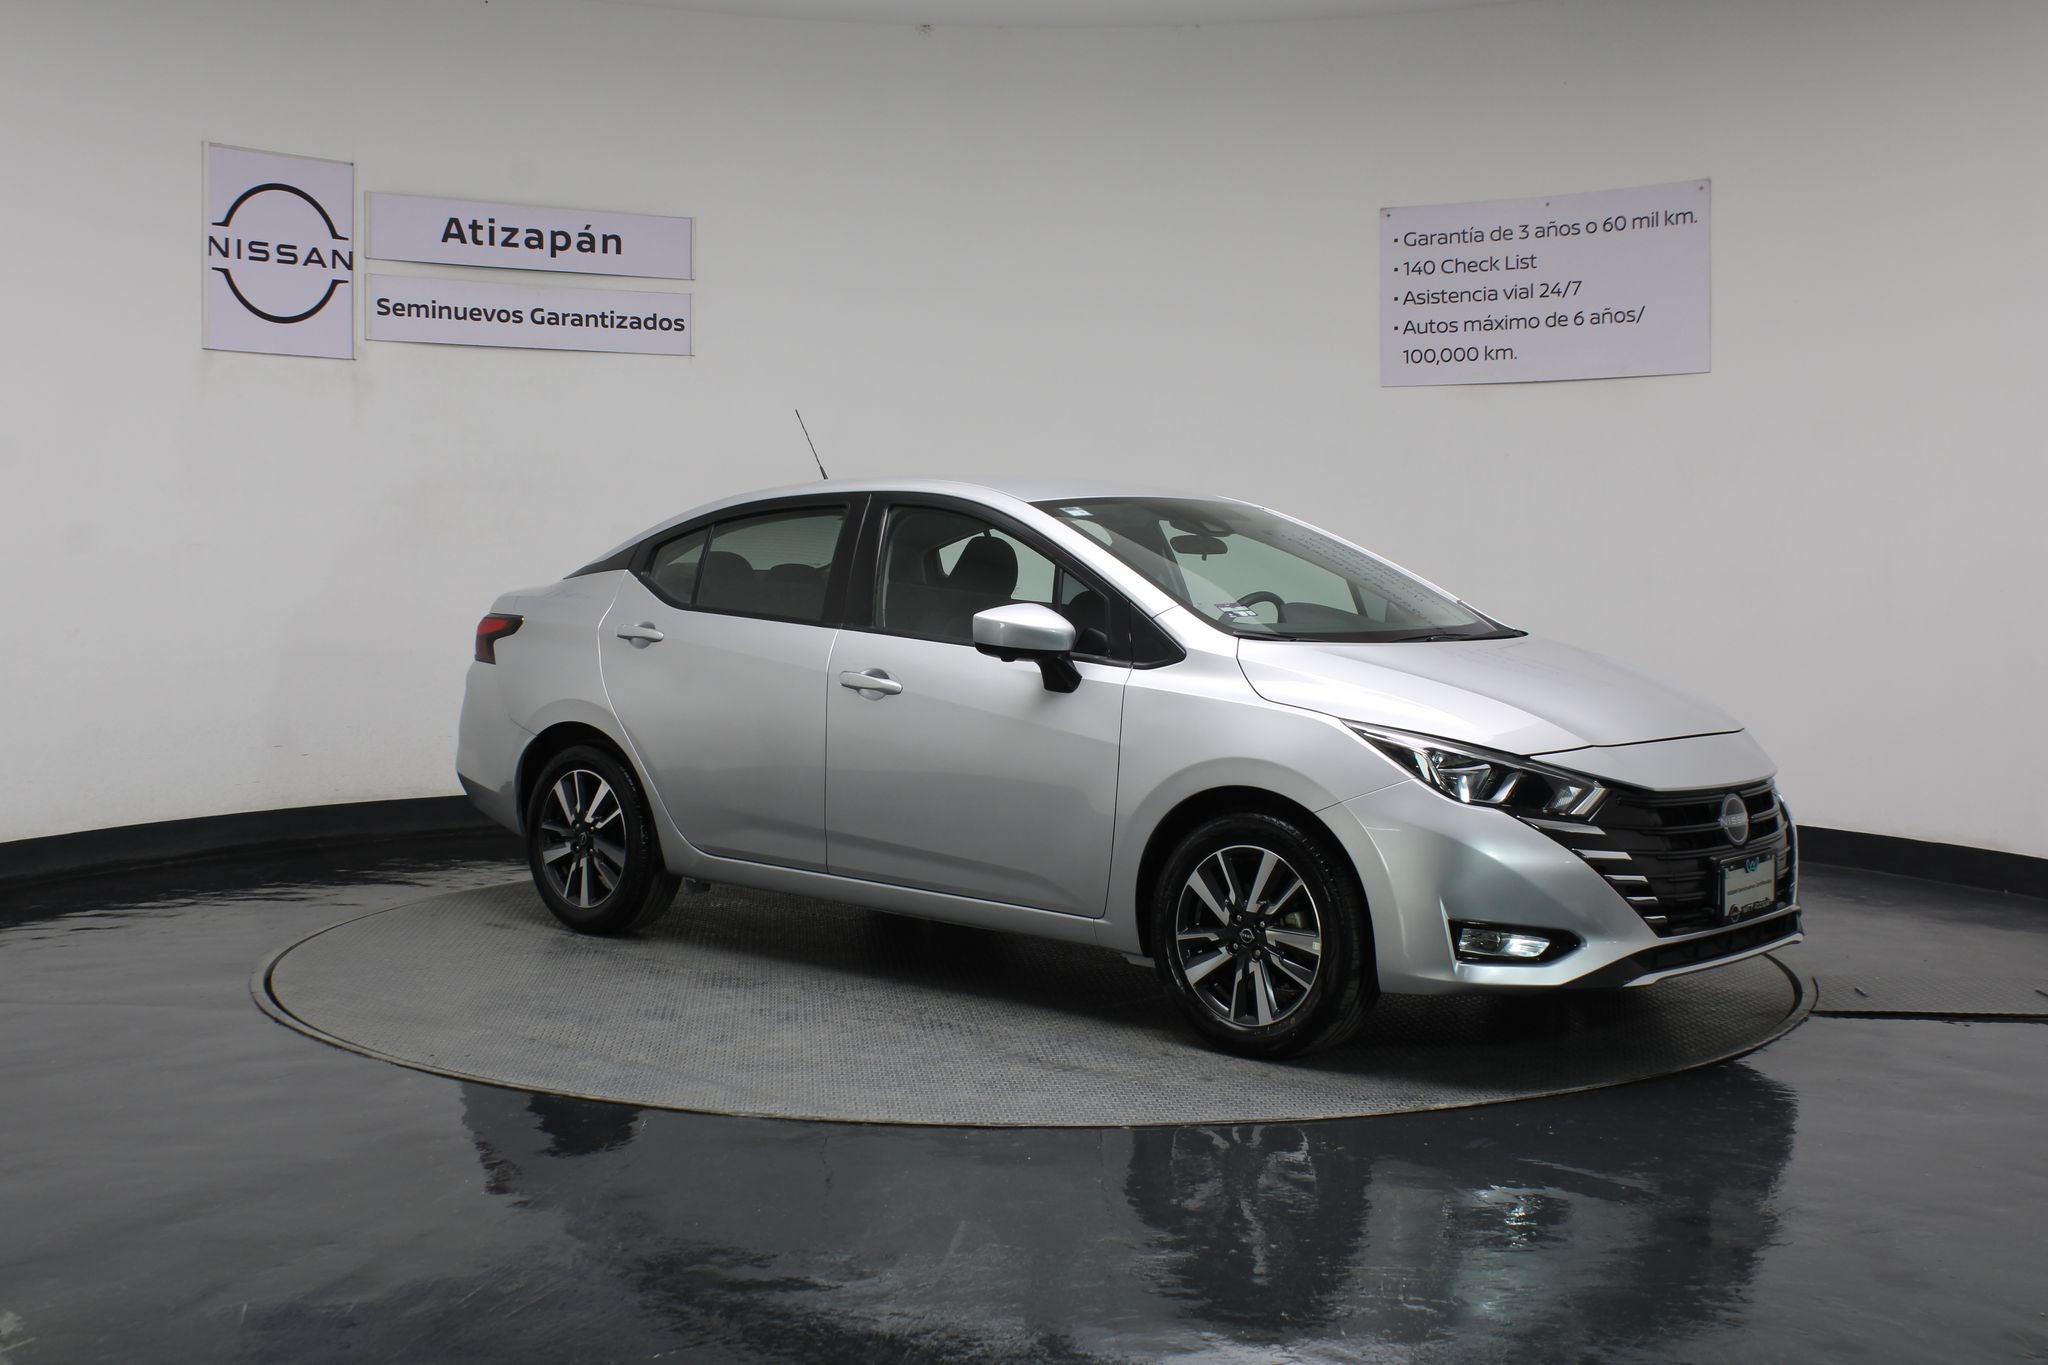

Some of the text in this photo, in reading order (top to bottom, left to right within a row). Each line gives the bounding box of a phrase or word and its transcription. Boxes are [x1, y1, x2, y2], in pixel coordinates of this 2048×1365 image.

[441, 217, 622, 259] Atizapán
[1403, 209, 1698, 247] Garantía de 3 años o 60 mil km.
[208, 235, 354, 272] NISSAN
[1403, 253, 1538, 277] 140 Check List
[1402, 280, 1583, 306] Asistencia vial 24/7
[376, 297, 685, 332] Seminuevos Garantizados
[1402, 305, 1646, 335] Autos máximo de 6 años/
[1402, 345, 1518, 366] 100,000 km.
